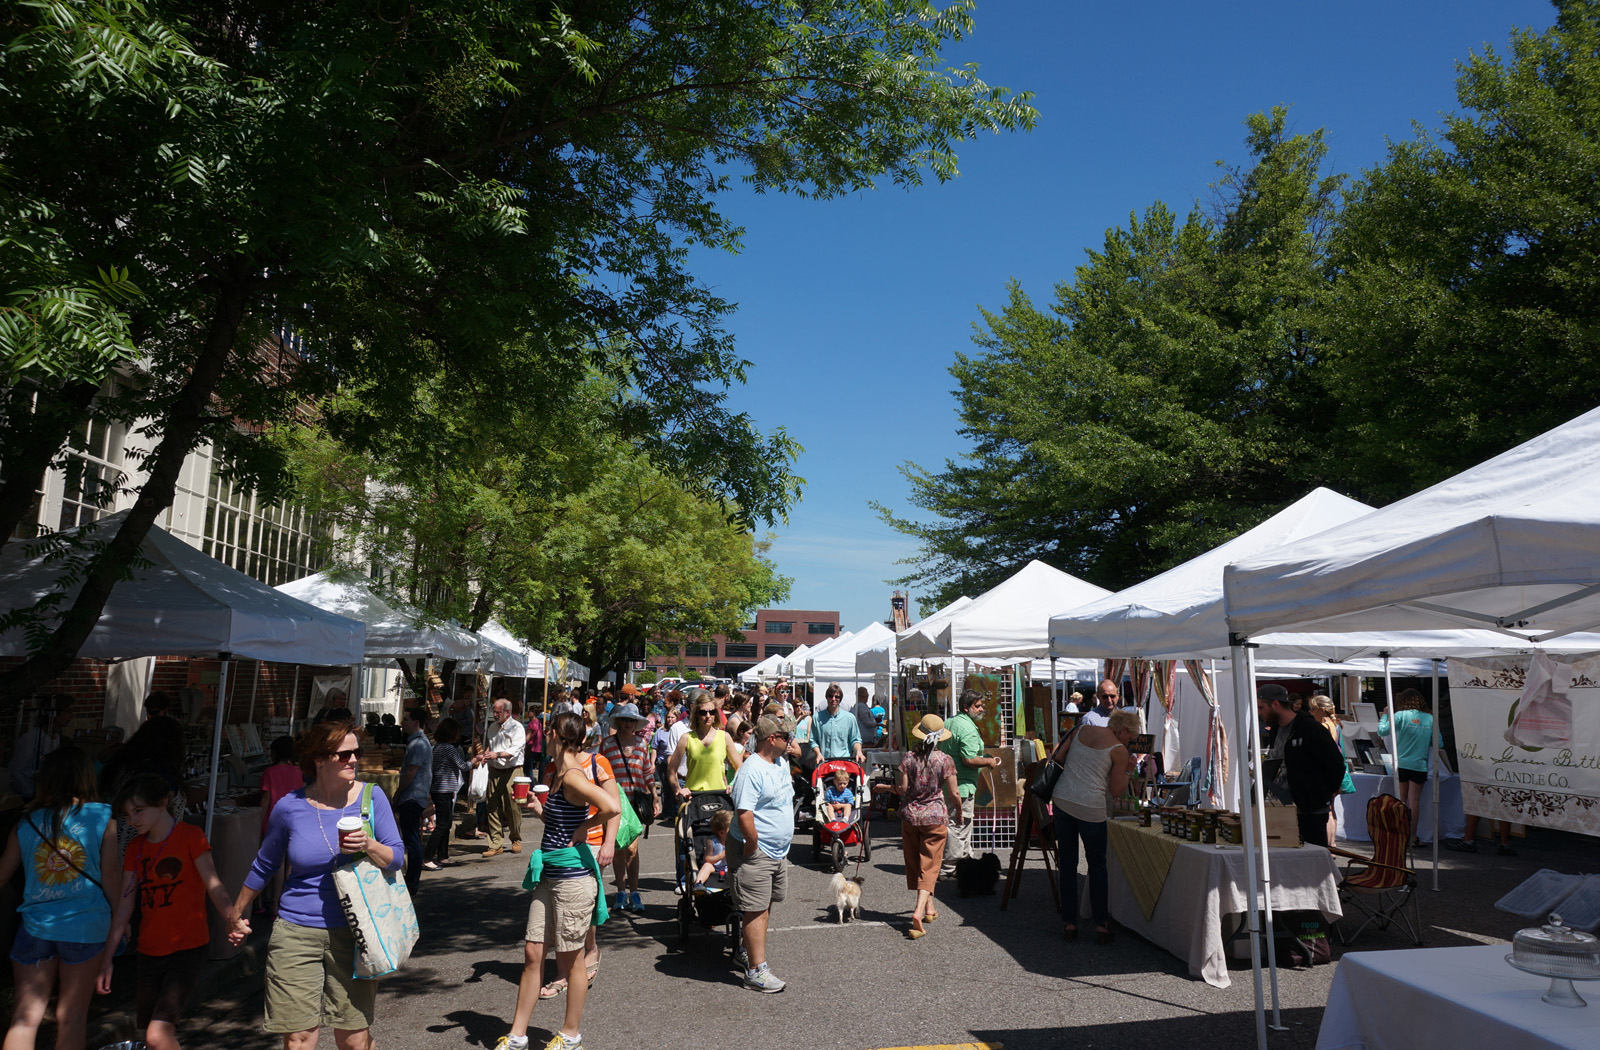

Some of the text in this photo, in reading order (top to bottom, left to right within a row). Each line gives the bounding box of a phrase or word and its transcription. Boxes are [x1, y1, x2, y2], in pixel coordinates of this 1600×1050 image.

[1460, 742, 1484, 761] The
[1490, 745, 1546, 765] Green
[1494, 767, 1546, 786] CANDLE
[32, 887, 65, 900] Love
[139, 880, 183, 910] NY
[1301, 921, 1320, 929] FOOD
